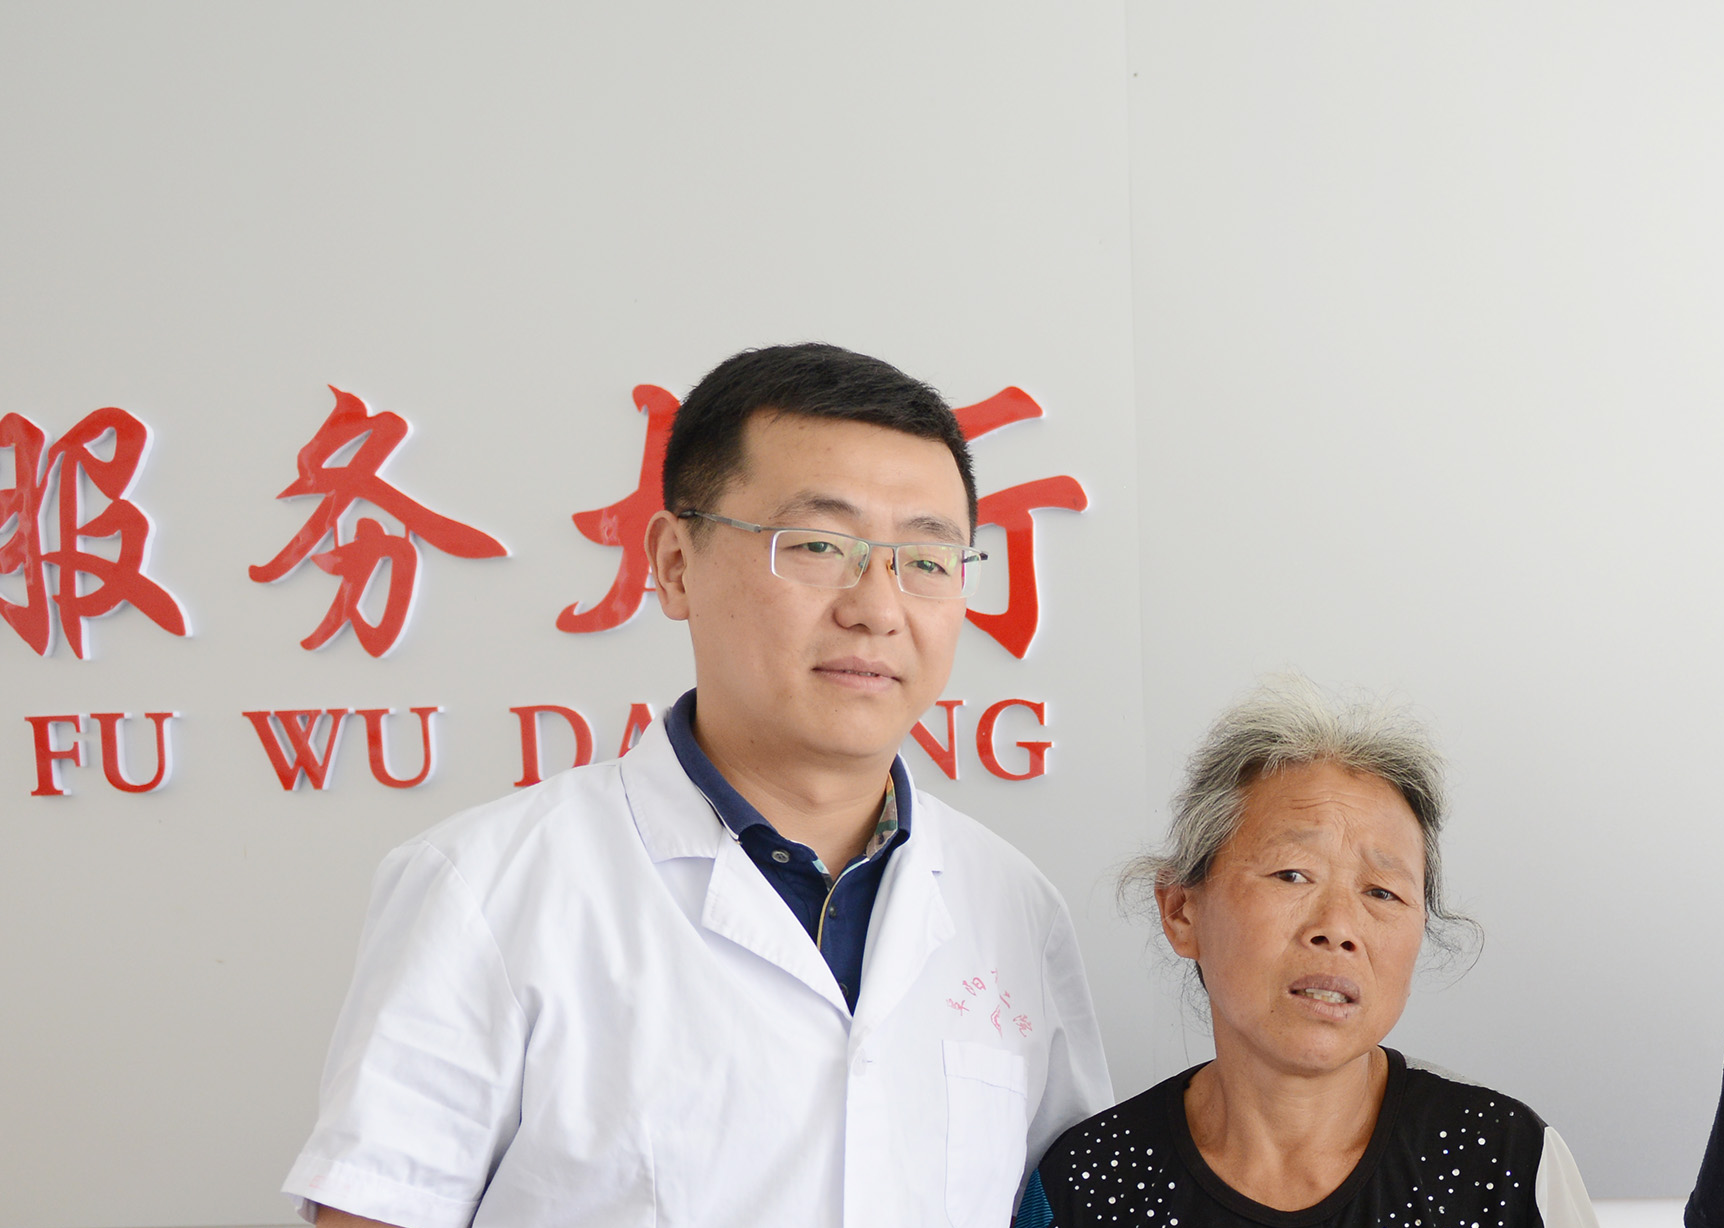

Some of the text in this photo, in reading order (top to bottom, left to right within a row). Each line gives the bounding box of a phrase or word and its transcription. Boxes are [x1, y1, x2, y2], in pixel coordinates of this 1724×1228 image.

[25, 713, 176, 796] FU
[243, 706, 443, 791] WU
[909, 698, 1053, 781] NG
